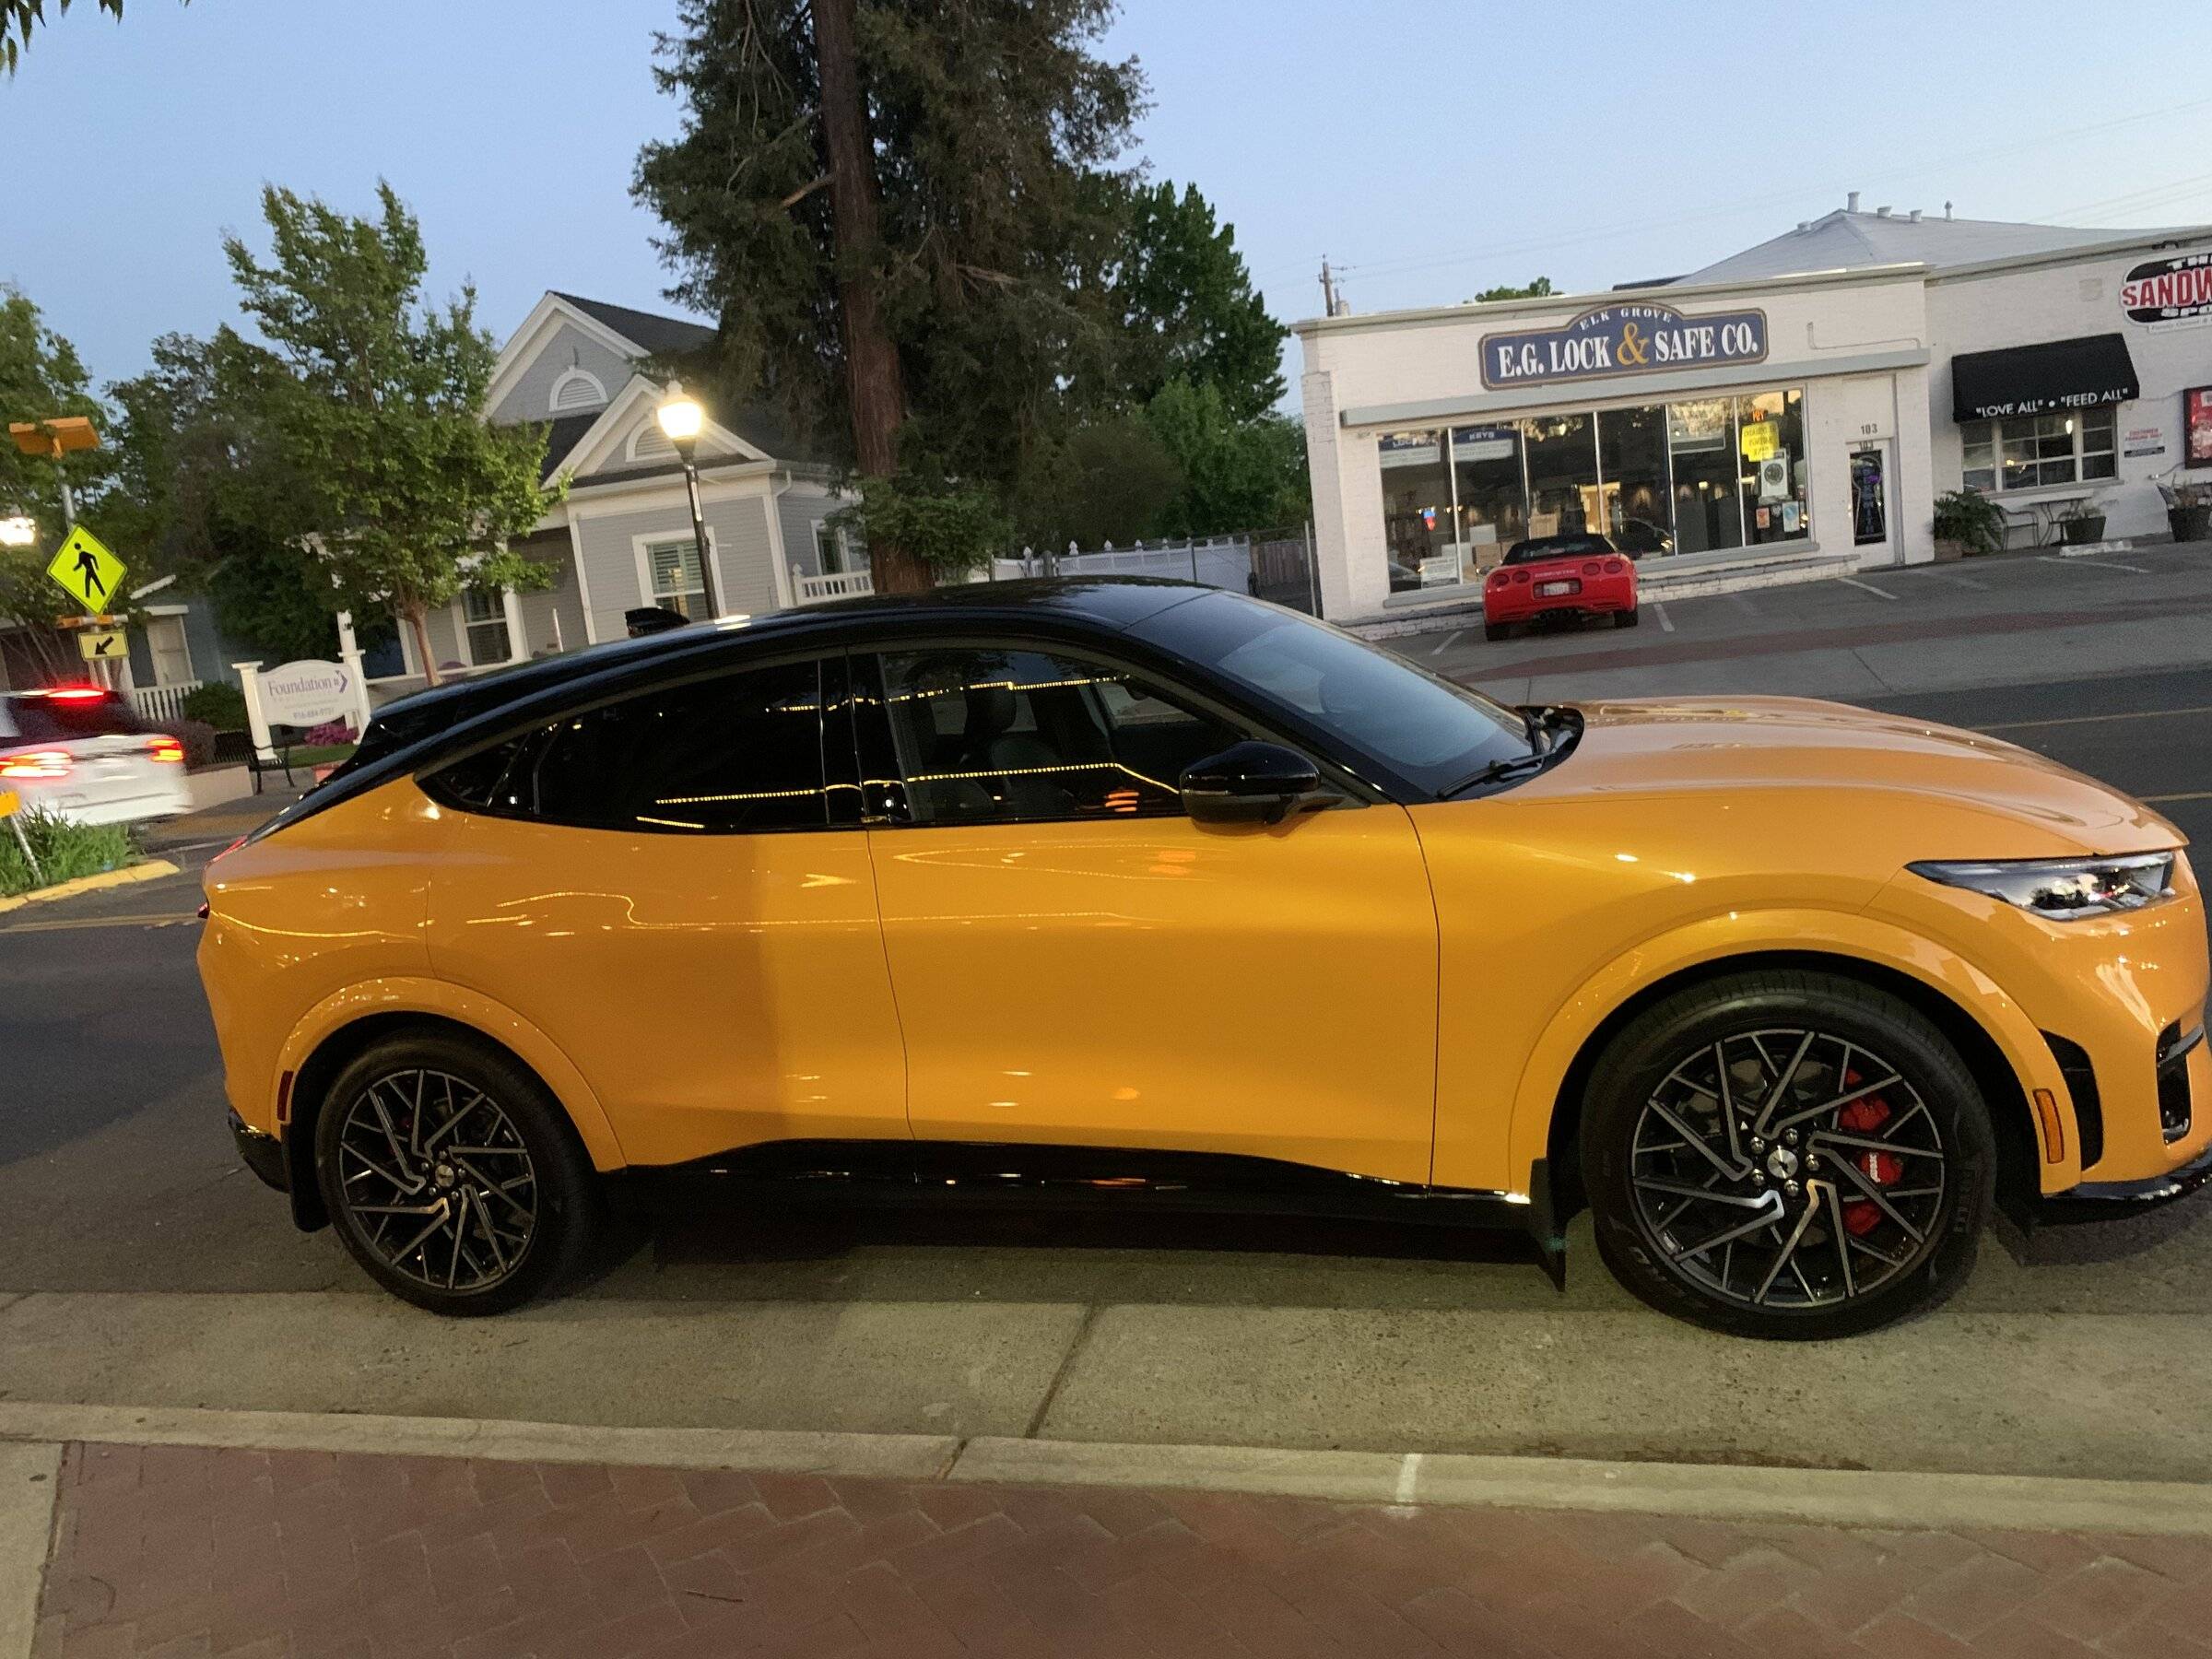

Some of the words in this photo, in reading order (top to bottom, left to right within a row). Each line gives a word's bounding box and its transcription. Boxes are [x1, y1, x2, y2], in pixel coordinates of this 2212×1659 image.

[1580, 311, 1609, 331] ELK
[1620, 307, 1672, 323] GROVE
[1498, 343, 1545, 379] E.G.
[1548, 336, 1612, 373] LOCK
[1617, 322, 1650, 366] &
[1654, 324, 1715, 362] SAFE
[1721, 322, 1759, 356] CO.
[1975, 404, 2014, 418] "LOVE
[2018, 398, 2043, 414] ALL"
[2060, 392, 2098, 407] "FEED
[2101, 387, 2128, 403] ALL"
[1860, 423, 1878, 436] 103
[267, 677, 332, 697] Foundation
